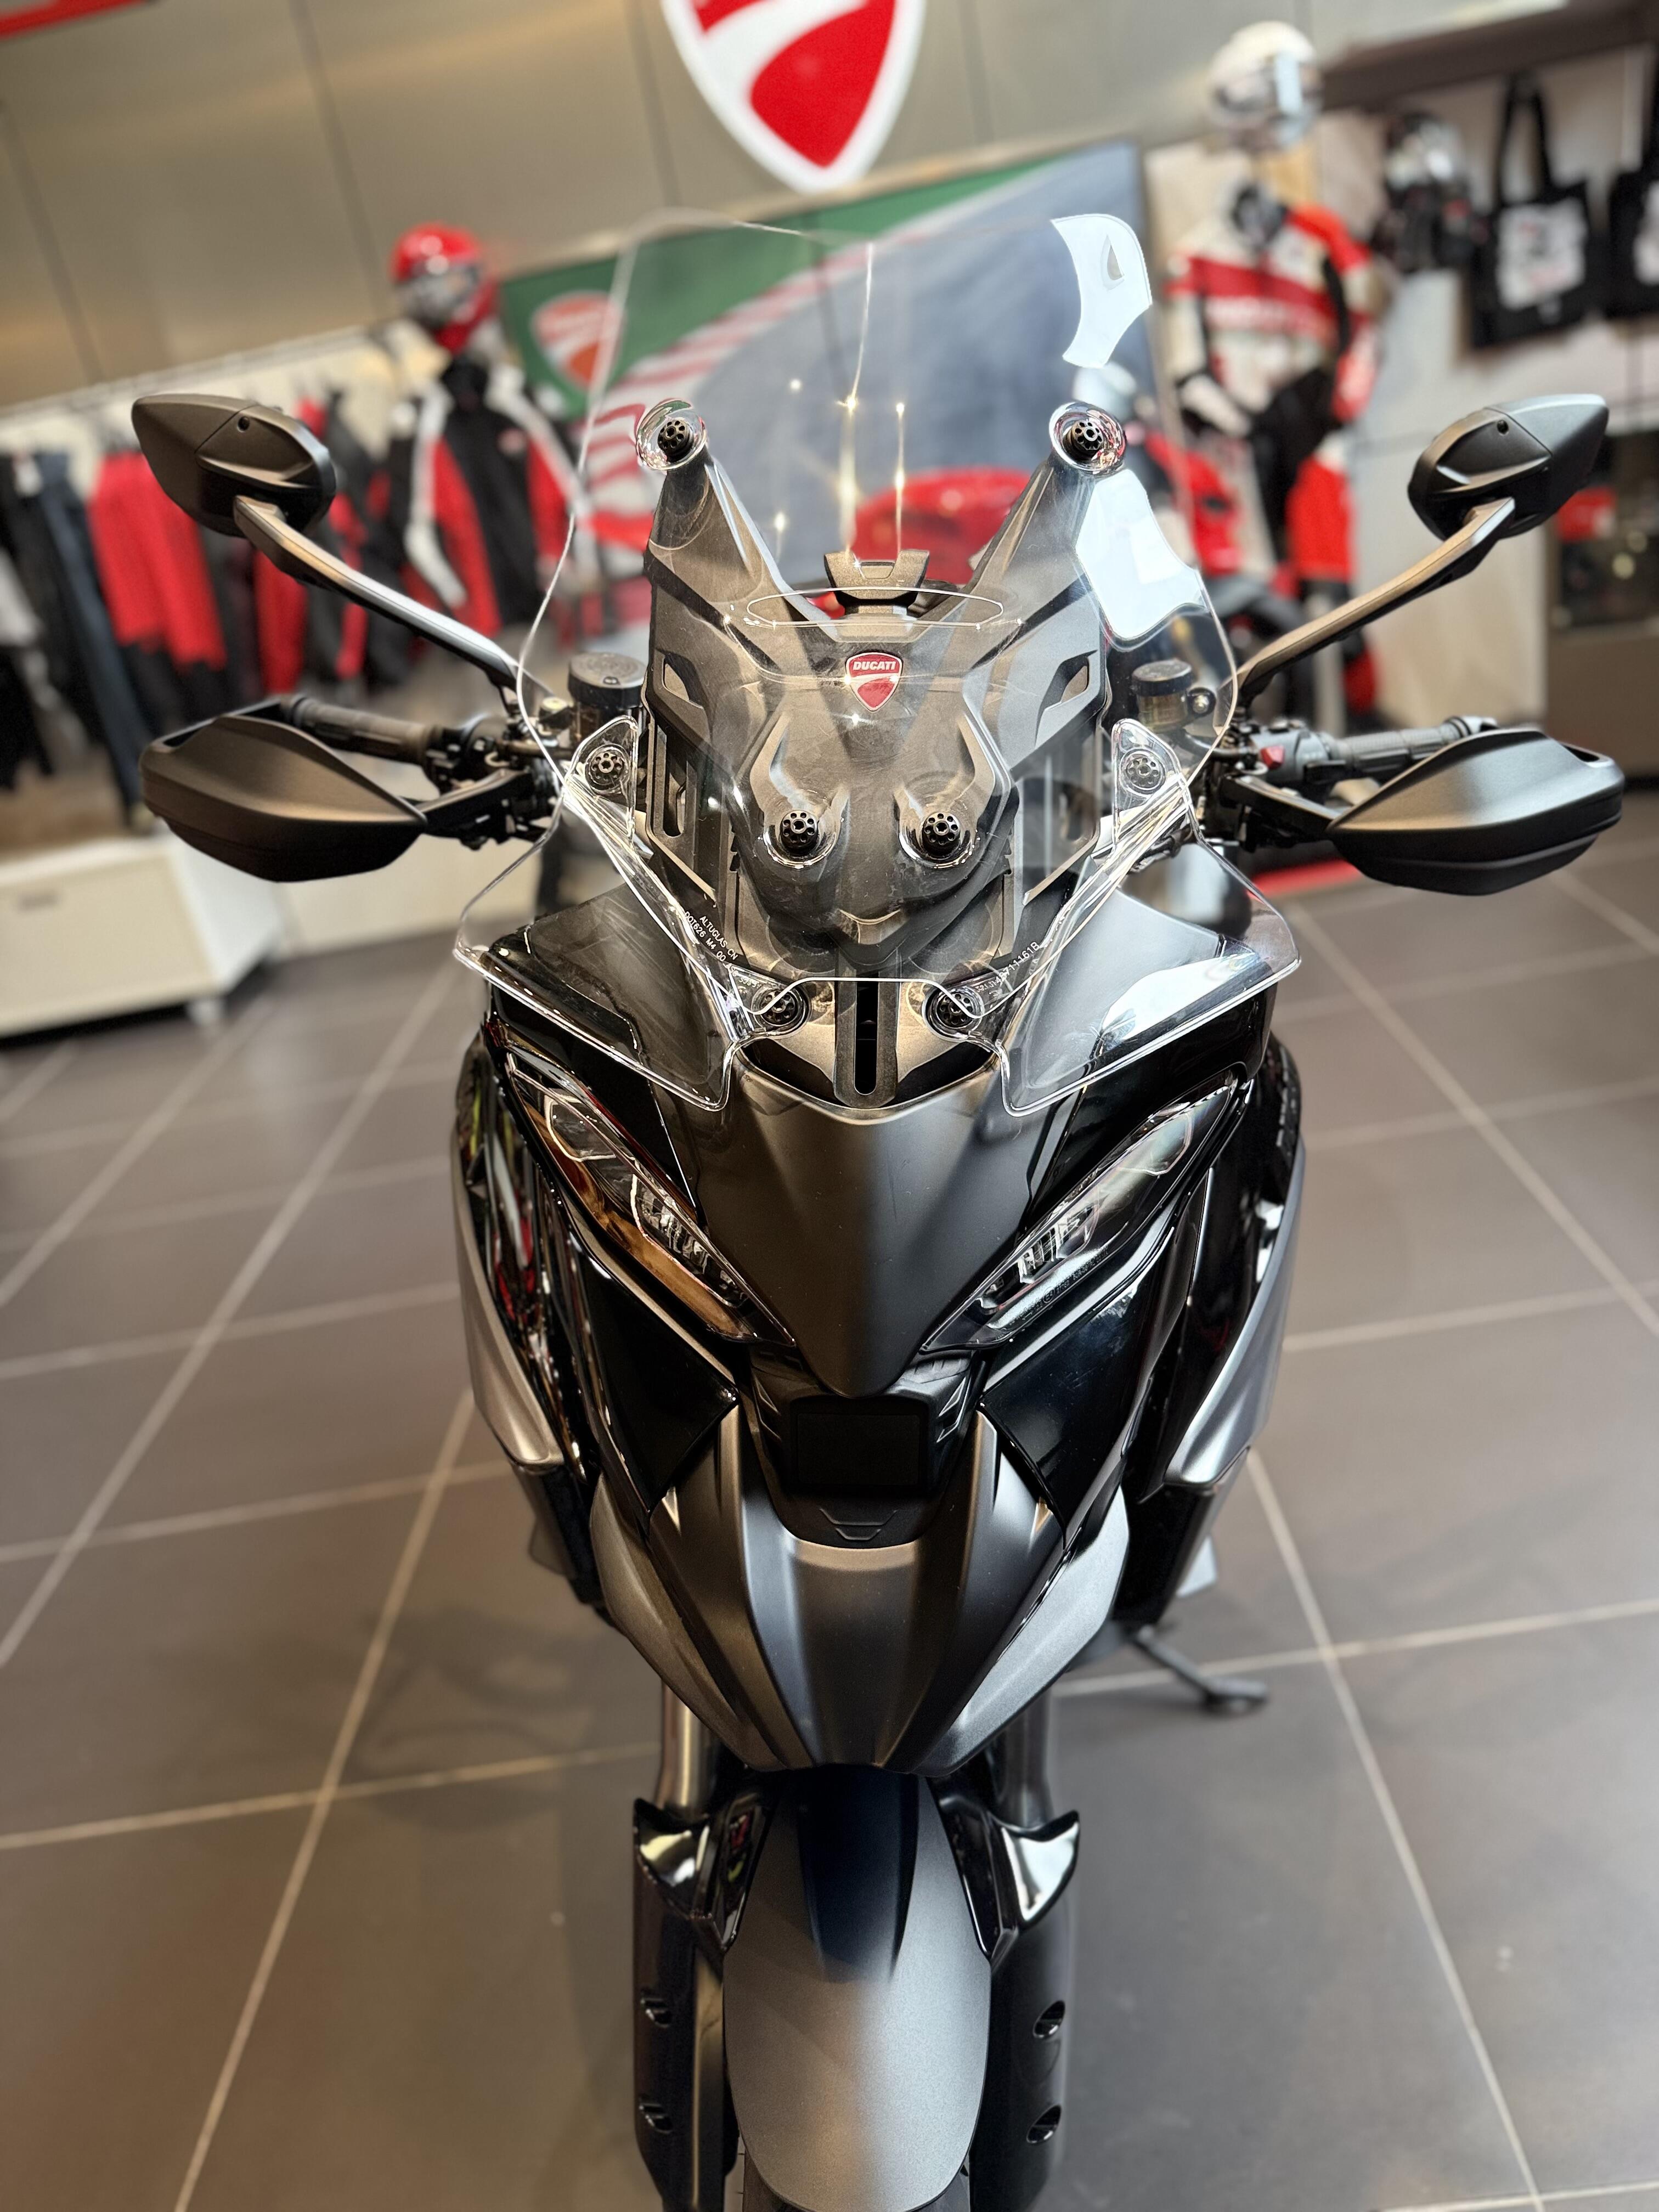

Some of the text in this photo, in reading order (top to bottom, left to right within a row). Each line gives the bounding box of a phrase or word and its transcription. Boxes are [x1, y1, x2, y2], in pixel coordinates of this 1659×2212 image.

[853, 661, 896, 670] DUCATI
[699, 916, 738, 960] ALTUGLAS CN
[706, 938, 716, 950] M4
